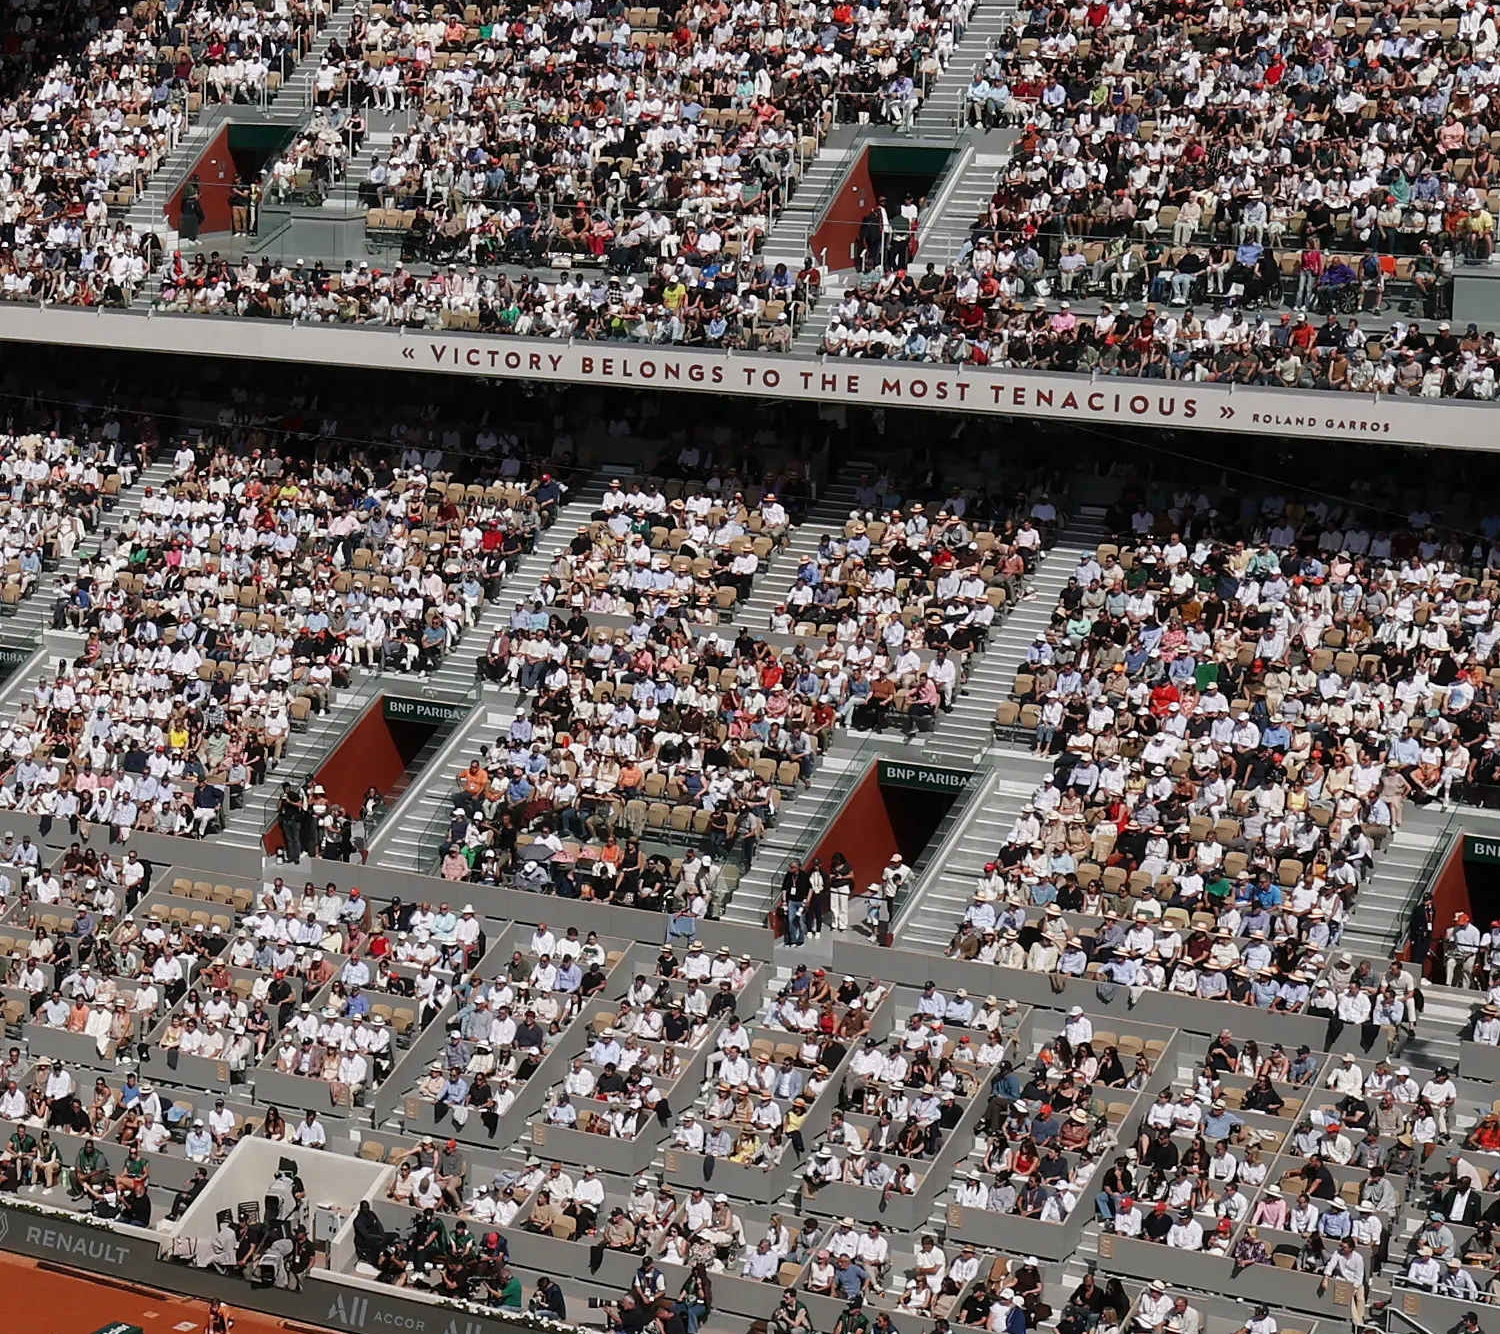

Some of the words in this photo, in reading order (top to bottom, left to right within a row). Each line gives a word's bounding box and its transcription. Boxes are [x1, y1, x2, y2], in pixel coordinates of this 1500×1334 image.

[430, 344, 563, 373] VICTORY
[582, 356, 724, 383] BELONGS
[742, 367, 781, 387] TO
[800, 372, 860, 394] THE
[880, 378, 971, 402] MOST
[990, 385, 1197, 419] TENACIOUS
[1252, 413, 1317, 429] ROLAND
[1325, 418, 1391, 433] GARROS
[389, 701, 415, 714] BNP
[416, 704, 467, 721] PARIBAS
[886, 766, 915, 780] BNP
[25, 1226, 130, 1265] RENAULT
[373, 1310, 426, 1332] ACCOR
